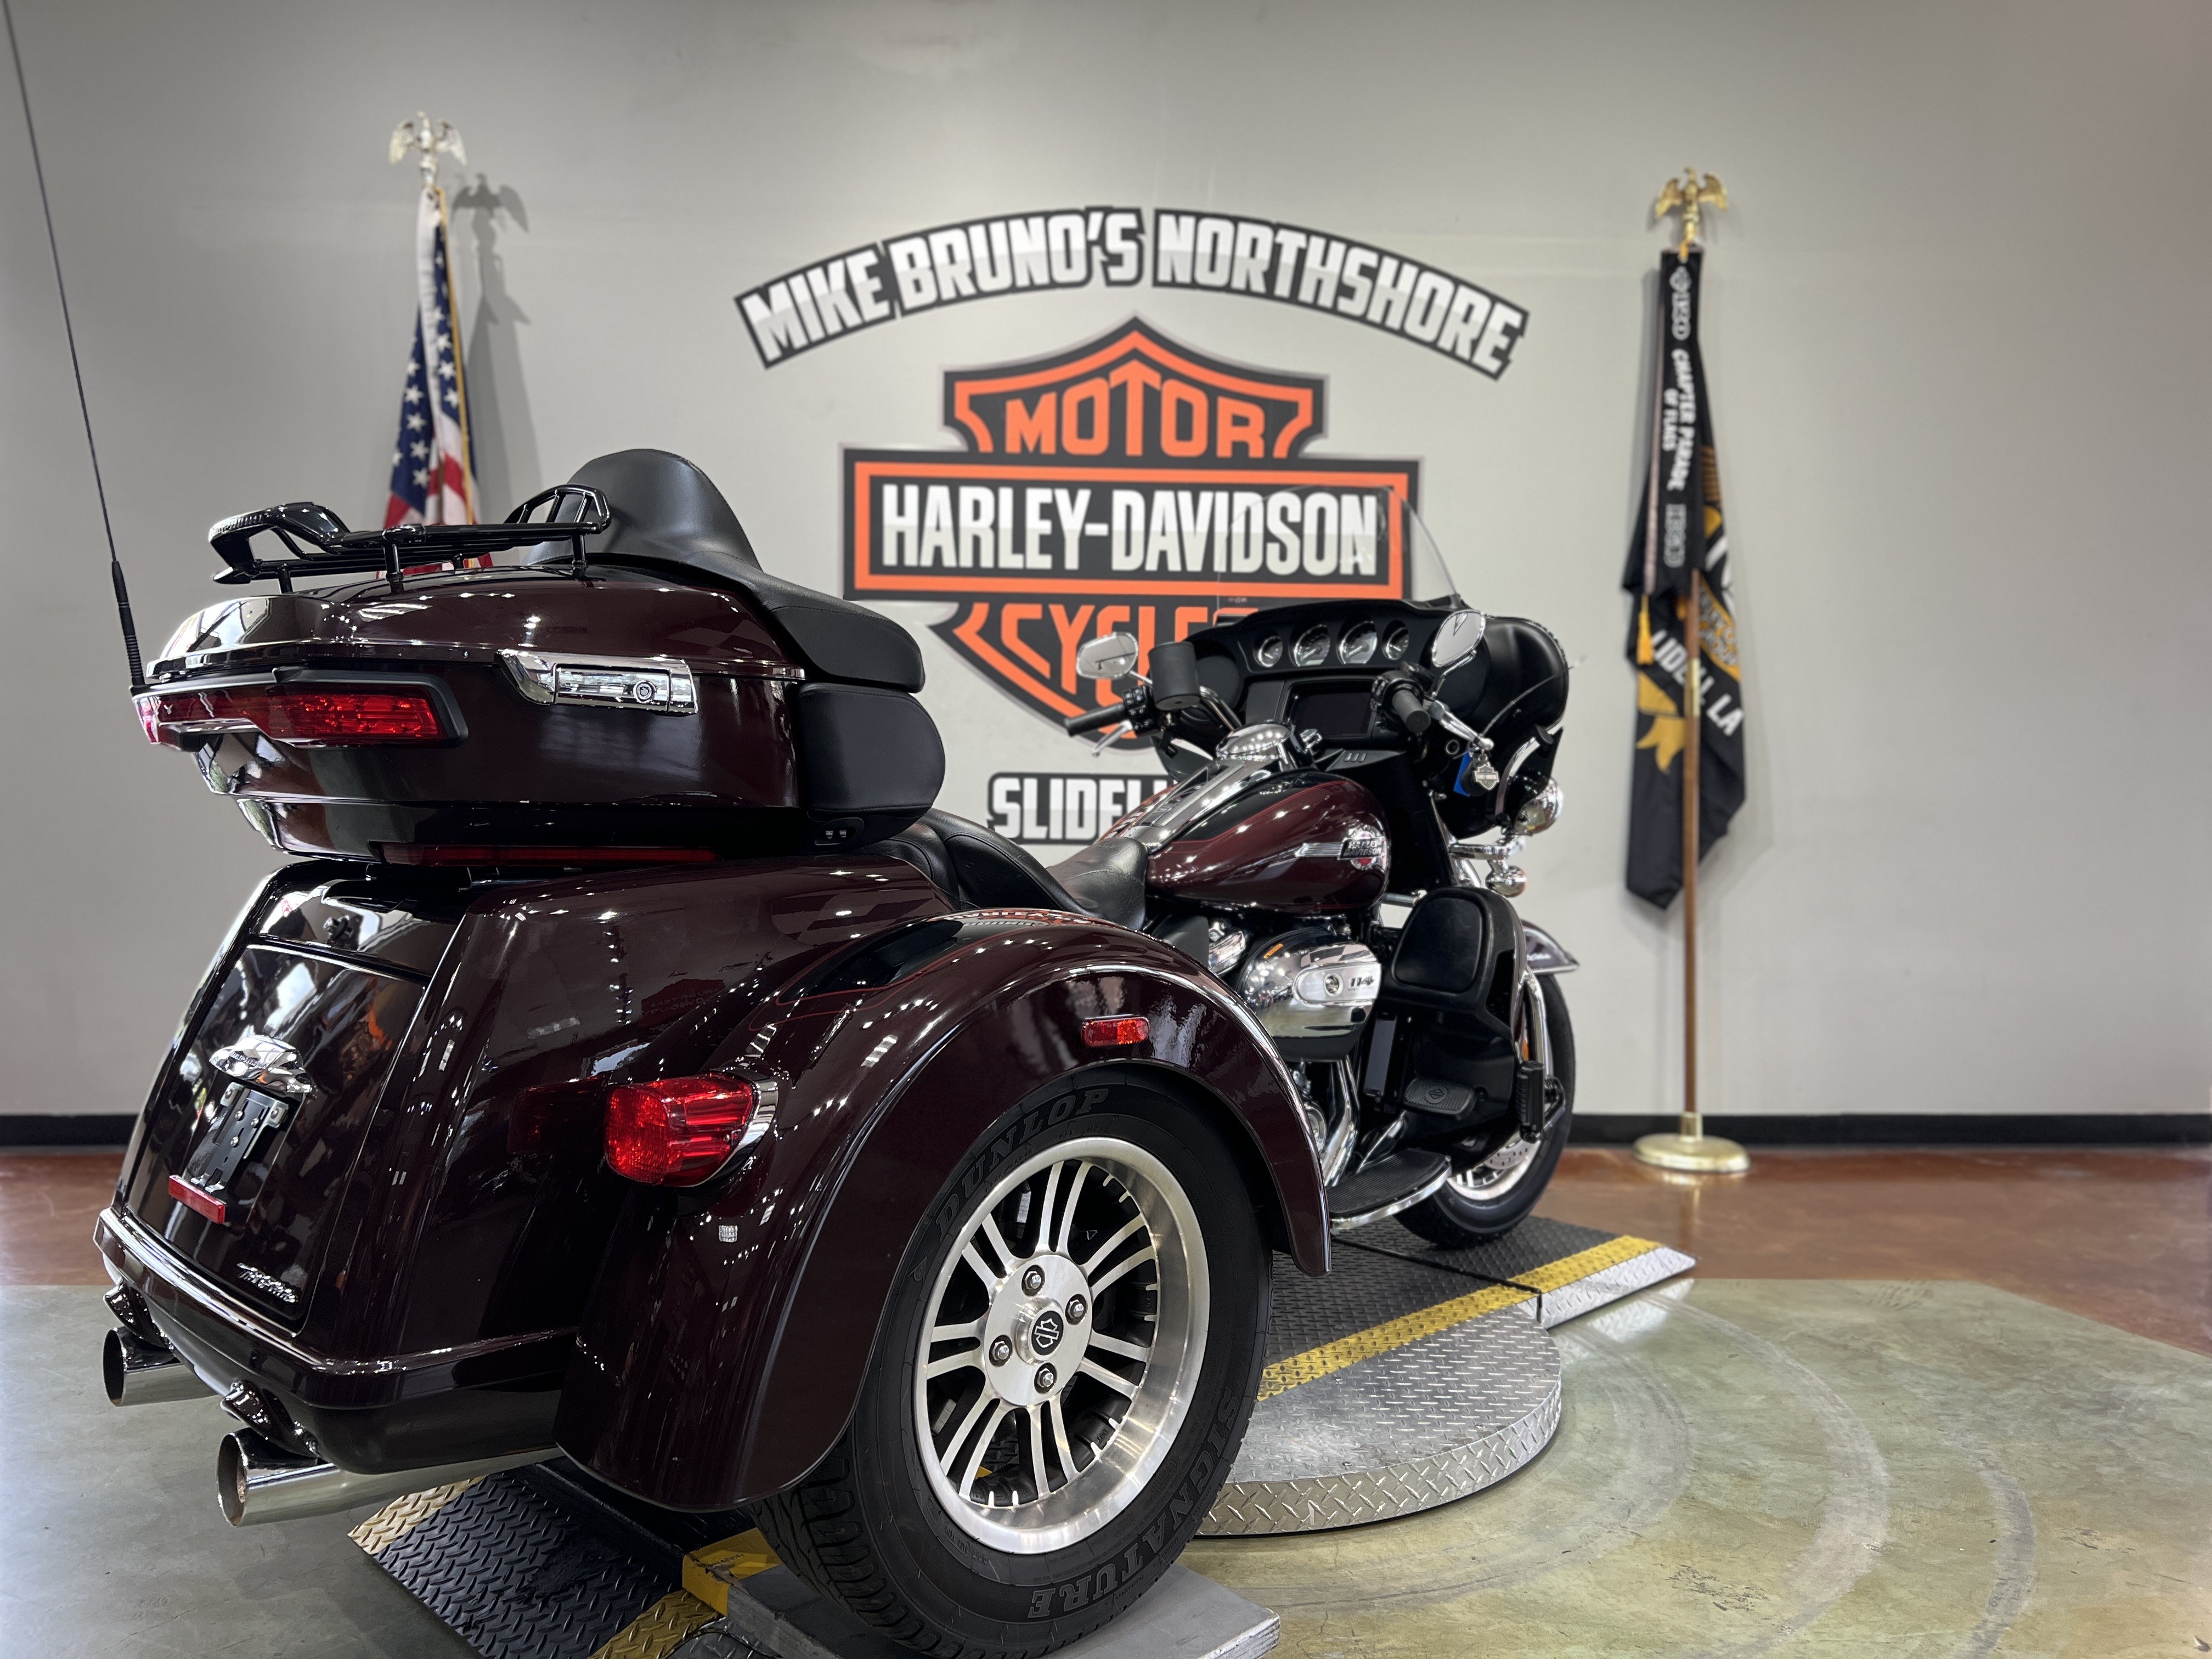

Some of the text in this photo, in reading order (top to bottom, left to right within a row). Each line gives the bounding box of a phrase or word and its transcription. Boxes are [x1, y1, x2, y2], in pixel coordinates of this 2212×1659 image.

[742, 212, 1523, 375] MIKE BRUNO'S NORTHSHORE
[1005, 359, 1266, 458] MOTOR
[1671, 348, 1696, 425] CHAPTER
[882, 483, 1377, 576] HARLEY-DAVIDSON
[1000, 602, 1259, 709] CYCL
[1706, 692, 1745, 737] LA
[992, 777, 1167, 840] SLIDE
[1350, 976, 1374, 987] 114
[935, 1088, 1109, 1243] DUNLOP
[1027, 1387, 1240, 1620] SIGNATURE
